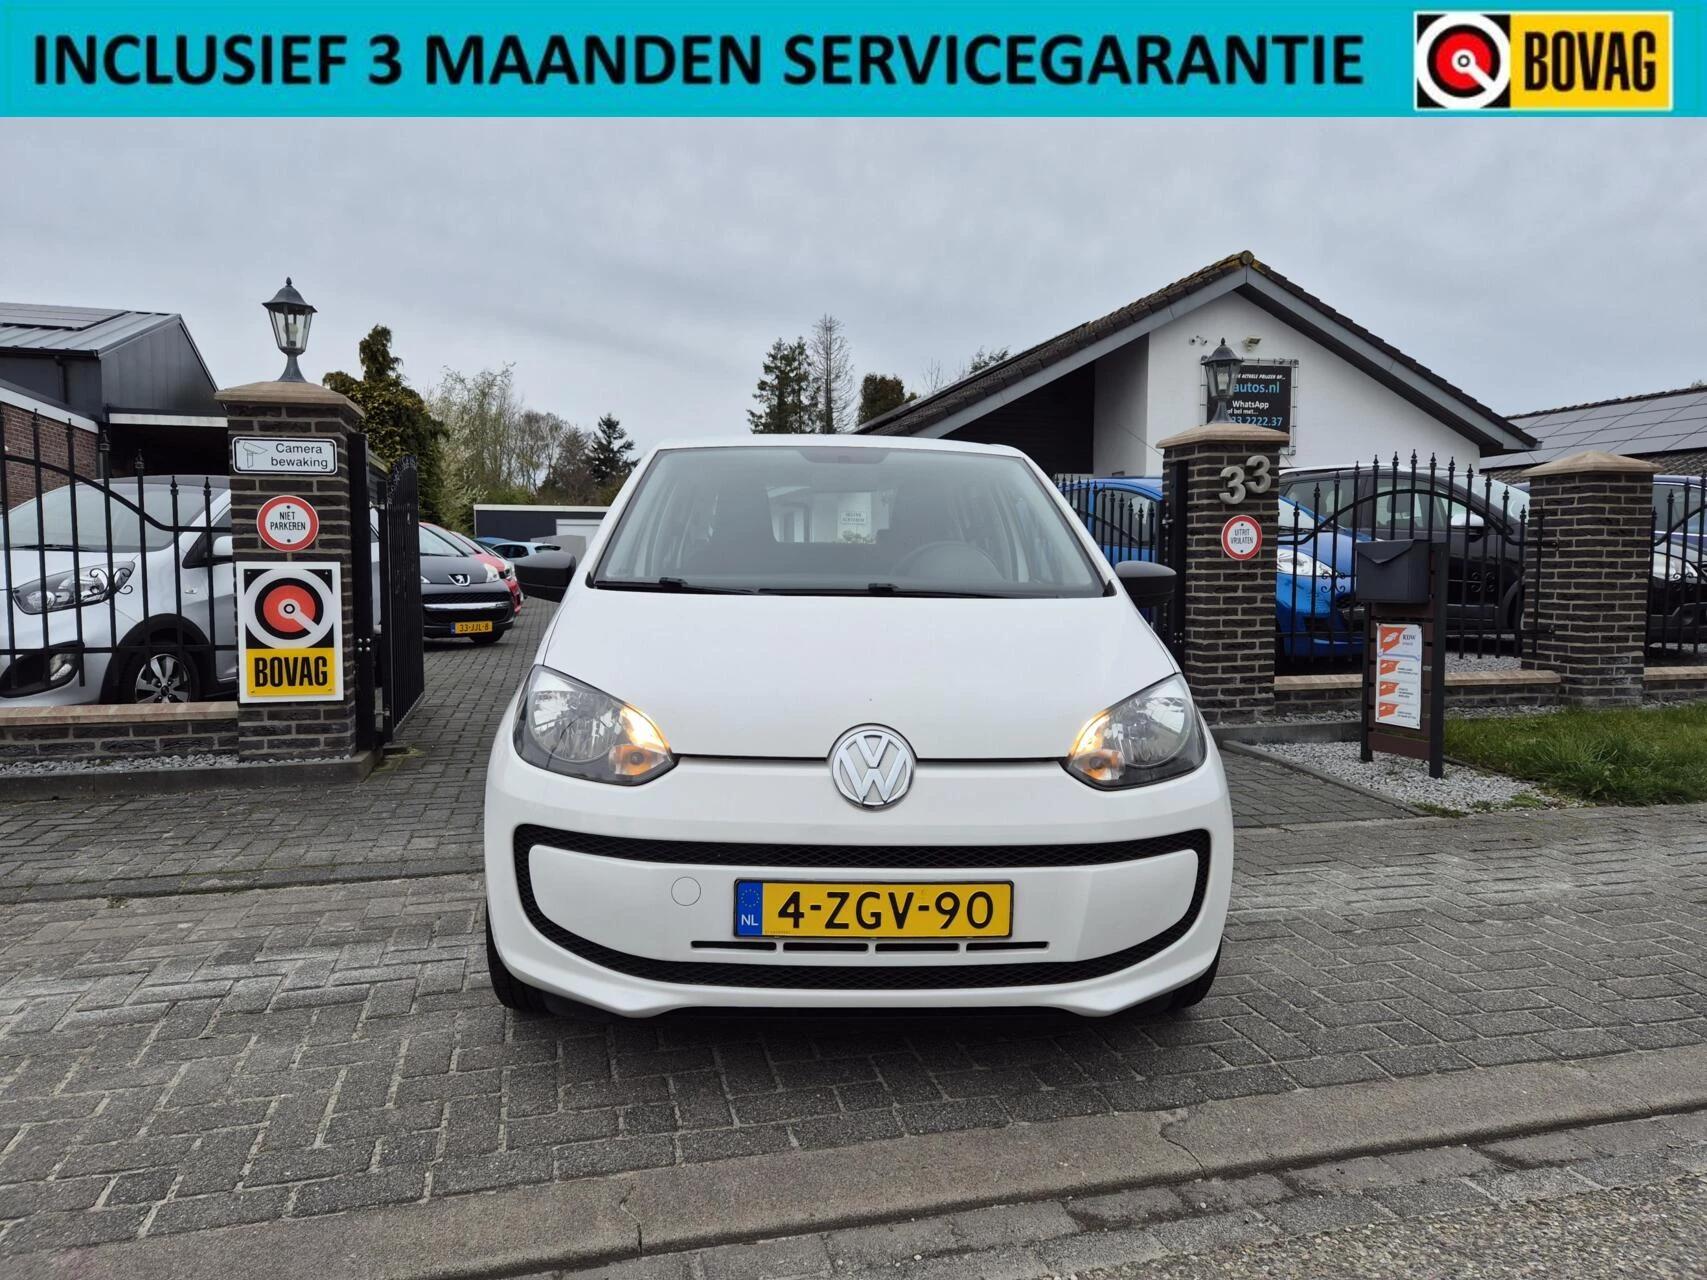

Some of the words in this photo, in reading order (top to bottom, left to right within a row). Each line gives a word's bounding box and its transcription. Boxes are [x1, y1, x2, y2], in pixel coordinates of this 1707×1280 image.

[1232, 400, 1269, 410] WhatsApp
[275, 442, 323, 454] Camera
[270, 456, 329, 470] bewaking
[1219, 454, 1272, 505] 33
[279, 511, 296, 520] NIET
[270, 521, 306, 531] PARKEREN
[1234, 528, 1251, 536] UITRIT
[254, 655, 328, 688] BOVAG
[777, 890, 995, 930] 4-ZGV-90
[741, 913, 759, 926] NL
